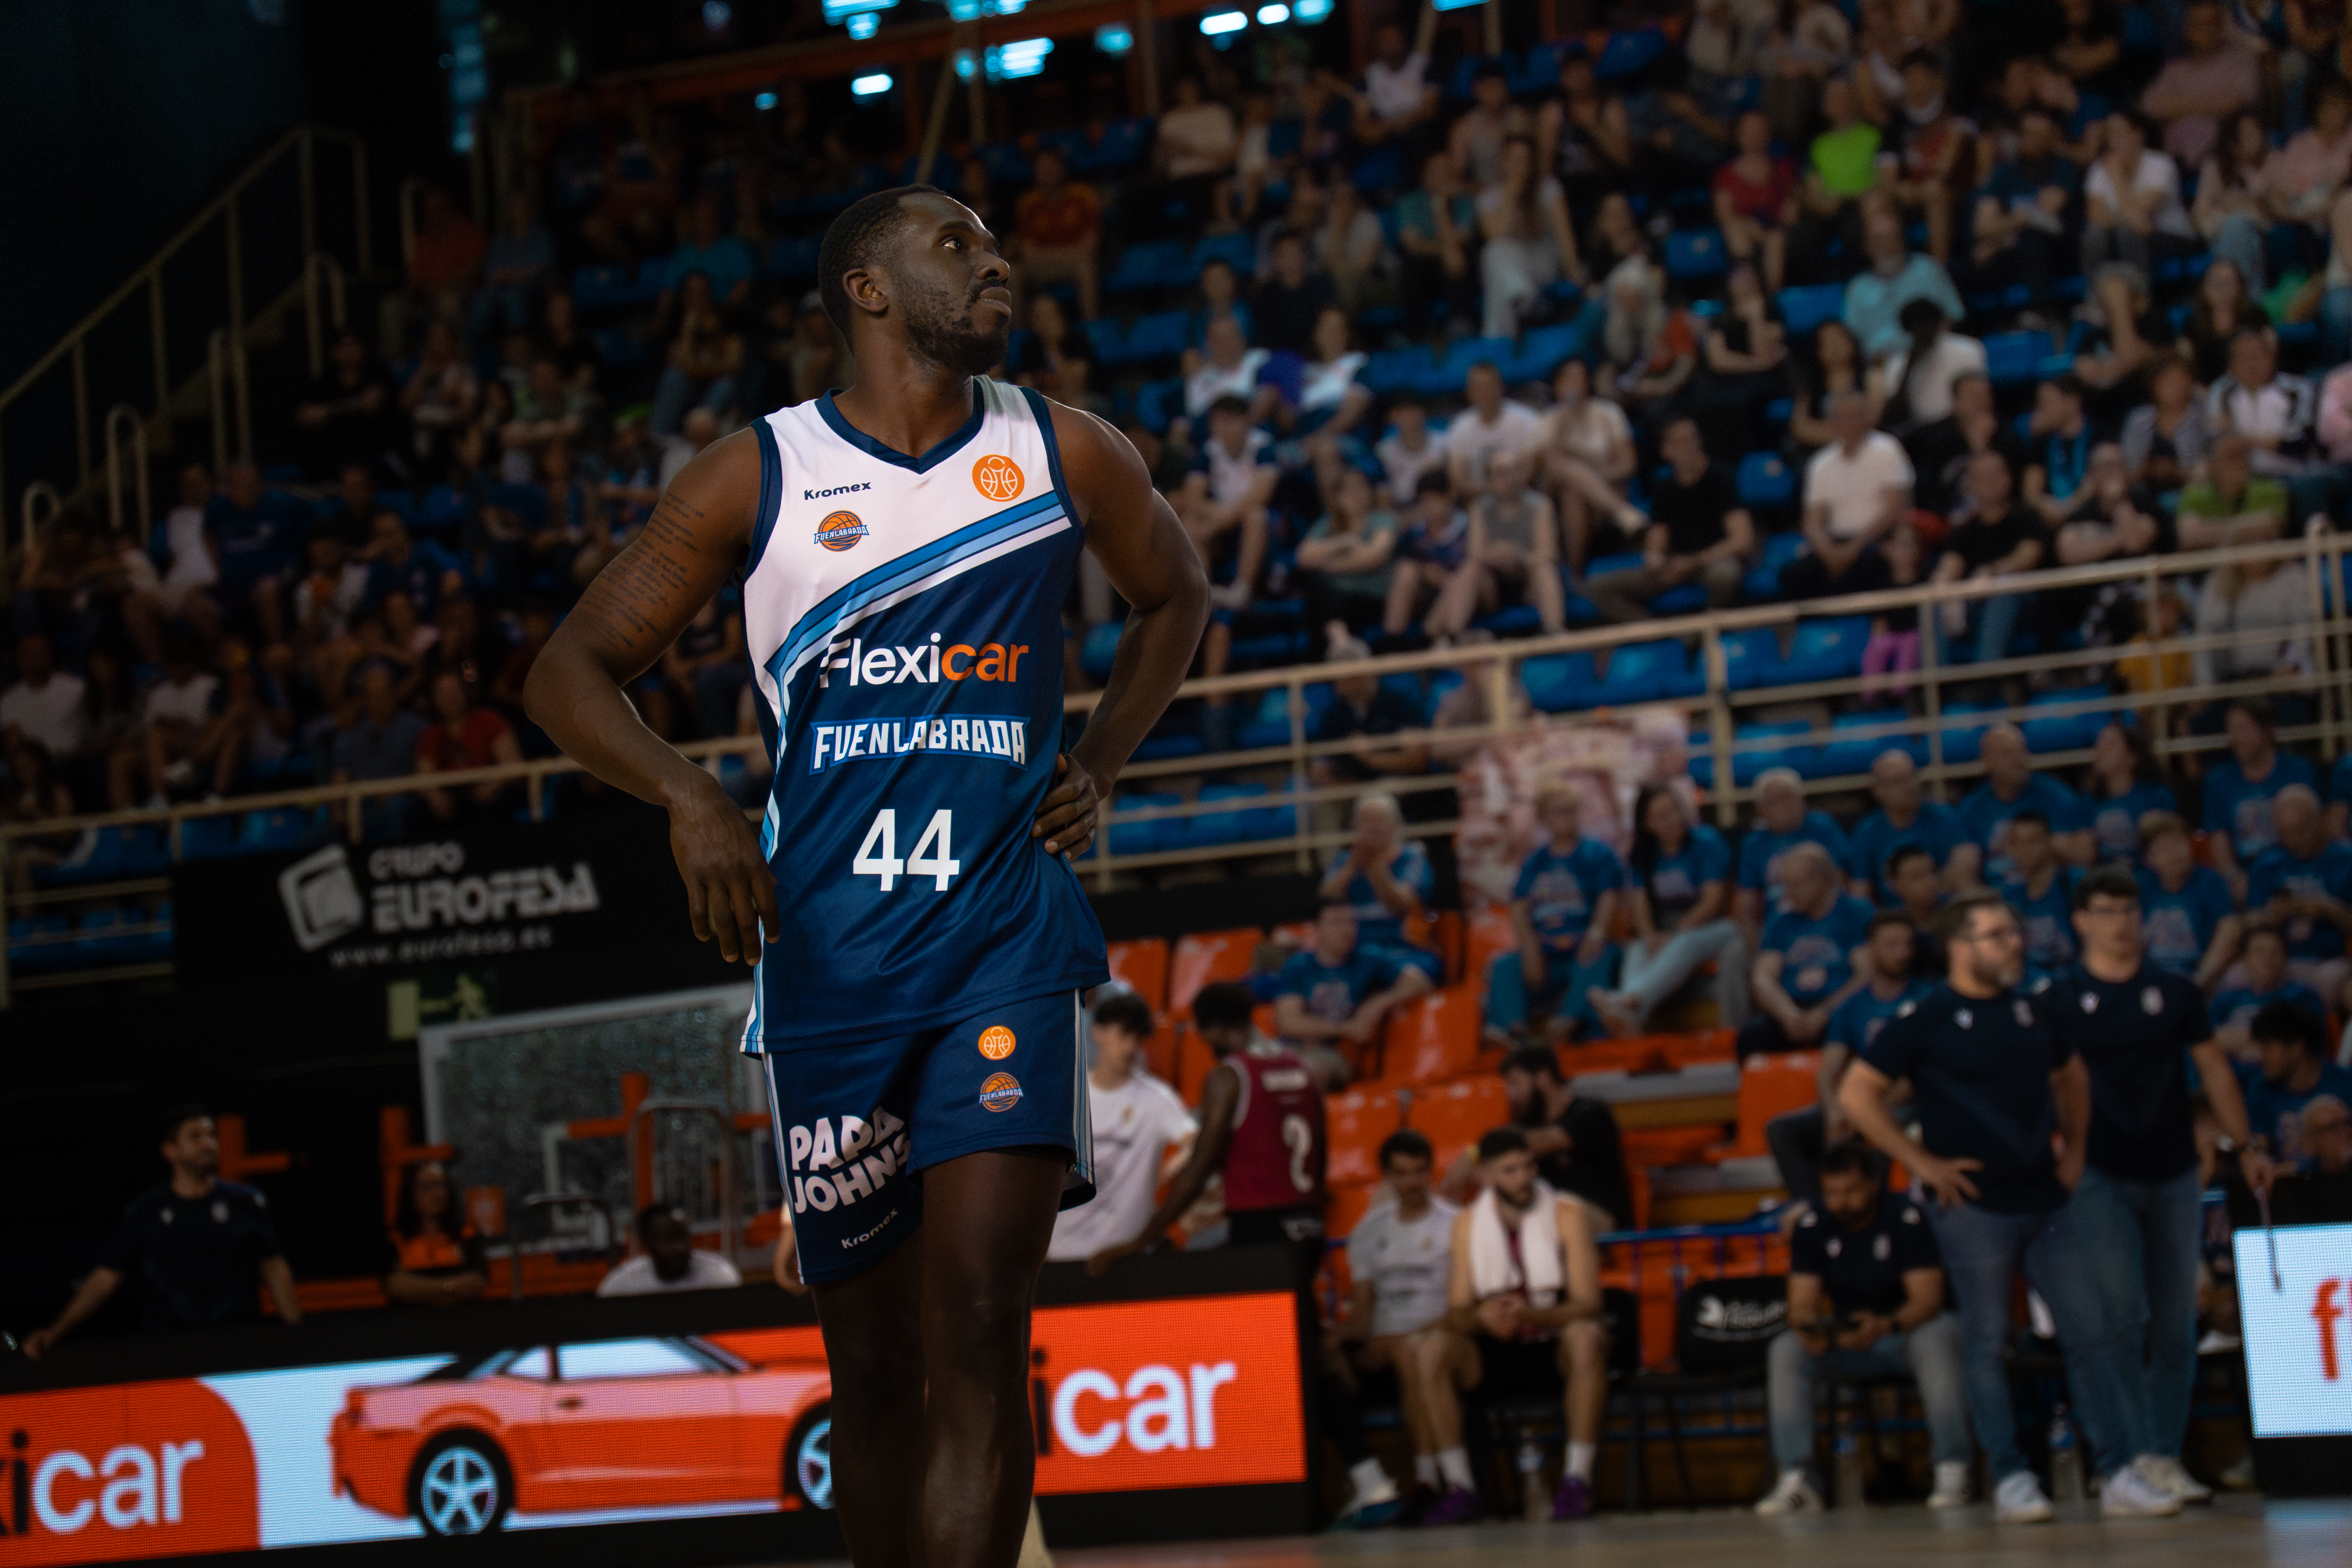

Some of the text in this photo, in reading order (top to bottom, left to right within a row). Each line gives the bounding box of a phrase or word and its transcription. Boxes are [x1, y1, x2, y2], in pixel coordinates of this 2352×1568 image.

[804, 481, 872, 501] Kromex
[814, 524, 869, 544] FUENLABRADA
[819, 632, 1029, 689] Flexicar
[813, 719, 1026, 770] FUENLABRADA
[853, 808, 960, 892] 44
[789, 1105, 905, 1172] PAPA
[841, 1208, 899, 1249] Kromex
[2312, 1277, 2352, 1382] f
